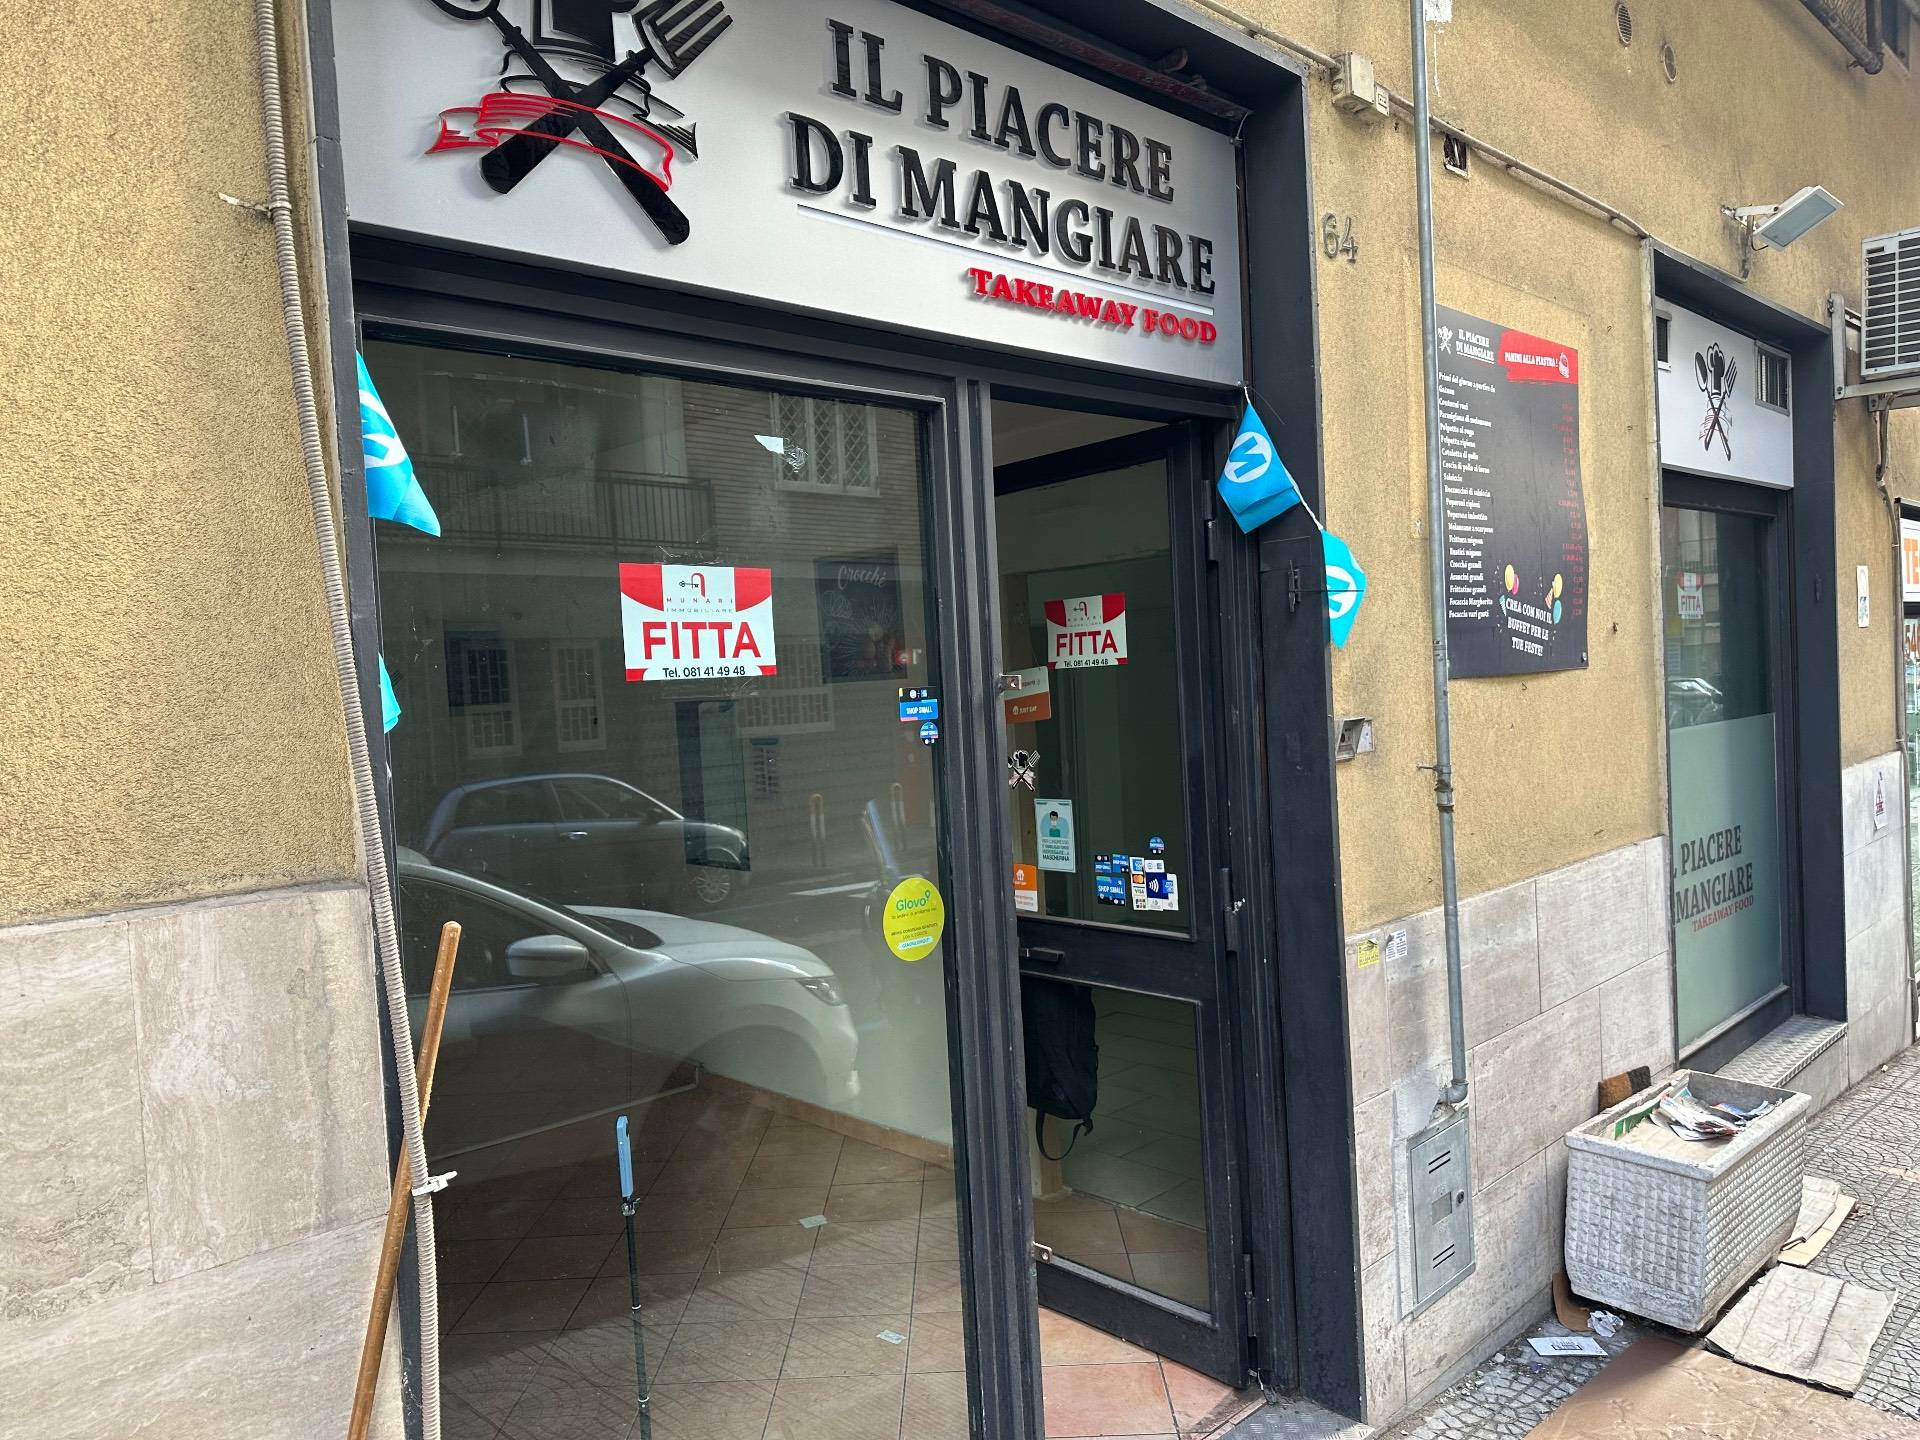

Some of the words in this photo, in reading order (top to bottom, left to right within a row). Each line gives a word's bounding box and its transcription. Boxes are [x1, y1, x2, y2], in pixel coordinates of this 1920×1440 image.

[826, 17, 902, 114] IL
[921, 53, 1174, 202] PIACERE
[785, 110, 877, 208] DI
[896, 143, 1215, 295] MANGIARE
[1322, 212, 1358, 264] 64
[968, 266, 1138, 329] TAKEAWAY
[1143, 306, 1217, 345] FOOD
[1464, 343, 1495, 362] MANGIARE
[1466, 332, 1490, 348] PIACERE
[1904, 538, 1920, 584] TE
[1506, 598, 1522, 614] CREA
[1522, 604, 1535, 618] CON
[1535, 608, 1546, 622] NOI
[1680, 595, 1700, 612] FITTA
[642, 622, 762, 660] FITTA
[1508, 617, 1530, 634] BUFFET
[1530, 625, 1541, 638] PER
[1542, 628, 1549, 640] LE
[1056, 630, 1118, 656] FITTA
[1512, 637, 1524, 651] TUE
[1524, 640, 1544, 656] FESTE!
[662, 668, 680, 678] Tel.
[683, 667, 700, 677] 081
[704, 667, 714, 676] 41
[717, 666, 730, 676] 49
[733, 666, 746, 675] 48
[906, 706, 918, 714] SHOP
[919, 706, 932, 714] SMALL
[1680, 825, 1742, 876] PIACERE
[896, 894, 928, 911] Glovo
[1110, 886, 1124, 894] SMALL
[1676, 862, 1753, 924] MANGIARE
[1692, 904, 1734, 932] TAKEAWAY
[1735, 895, 1754, 913] FOOD
